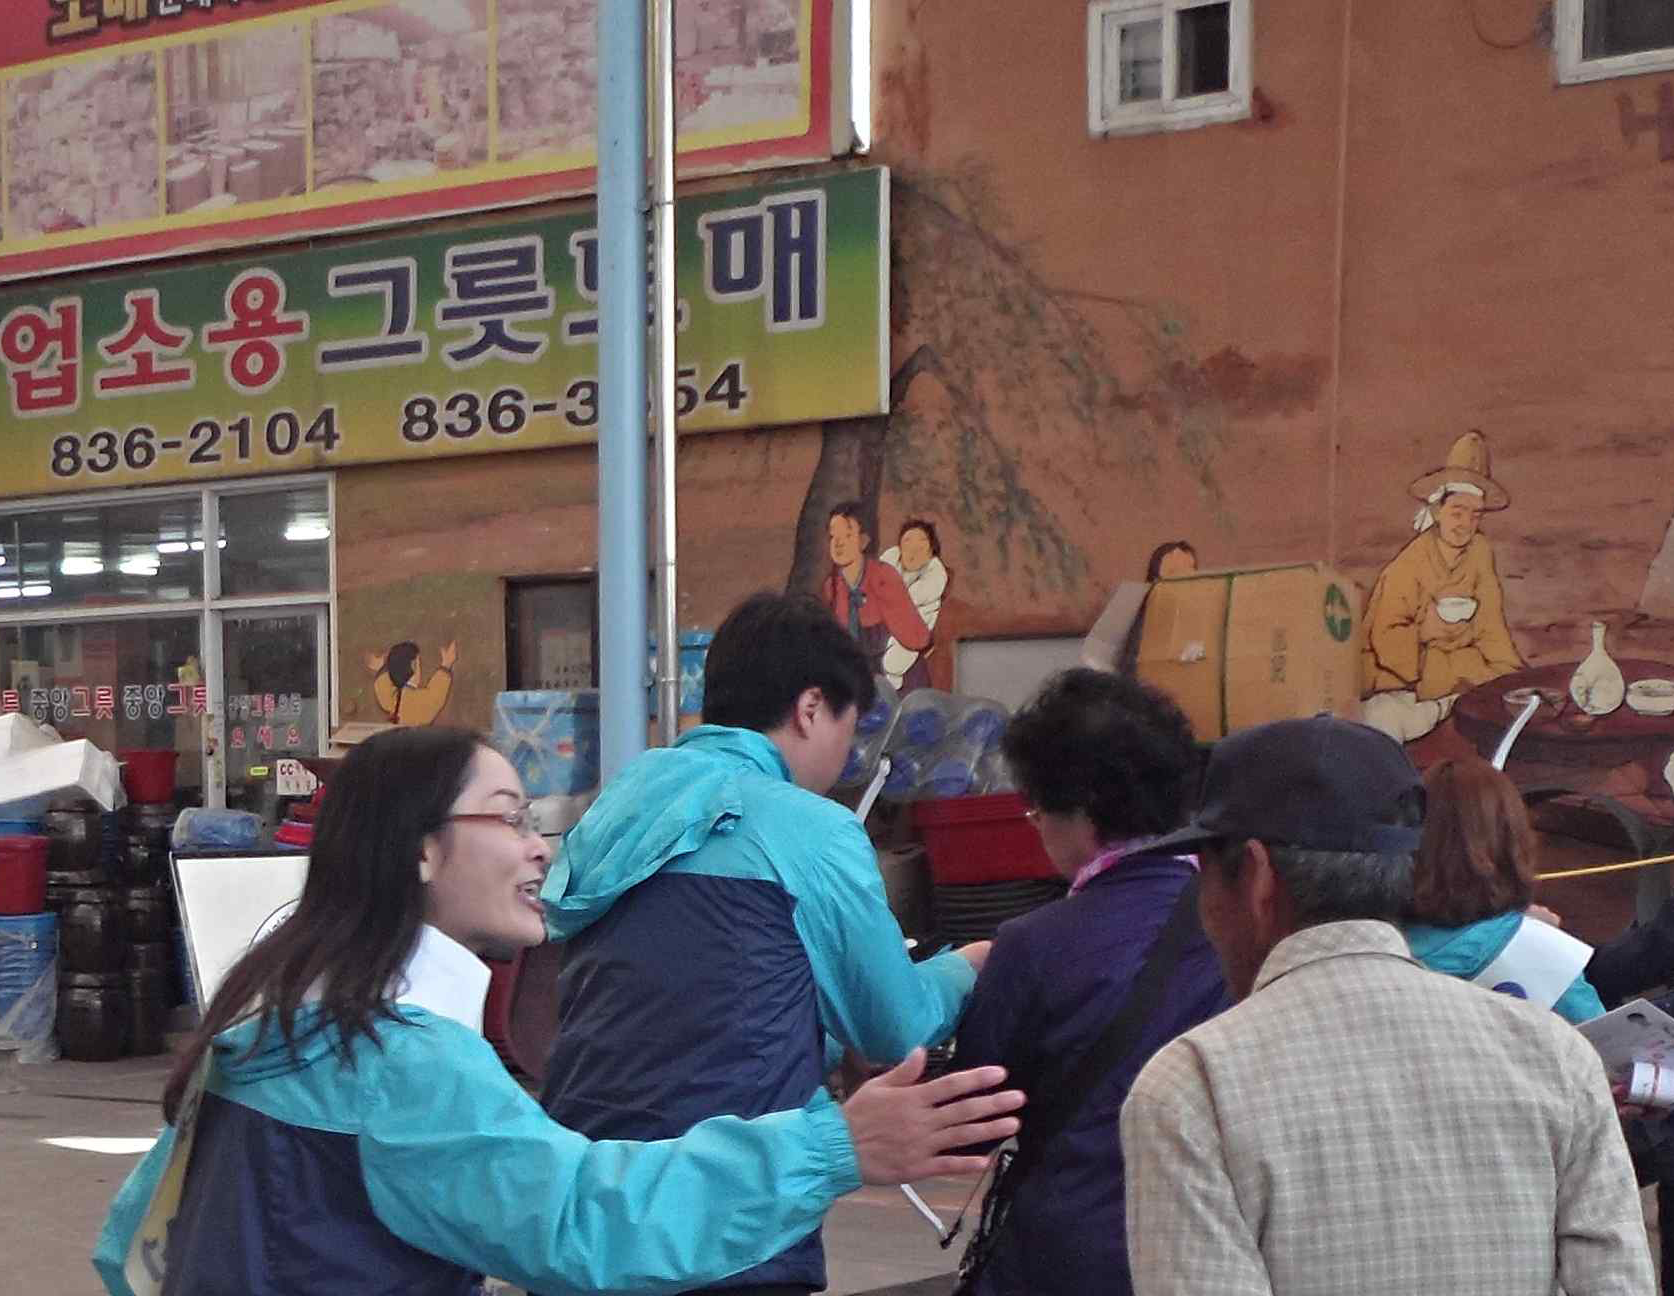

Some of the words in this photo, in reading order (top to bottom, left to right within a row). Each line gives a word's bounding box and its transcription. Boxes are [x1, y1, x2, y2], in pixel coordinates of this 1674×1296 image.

[51, 406, 341, 478] 836-2104
[400, 361, 747, 444] 836-354
[29, 686, 114, 722] 중앙그릇
